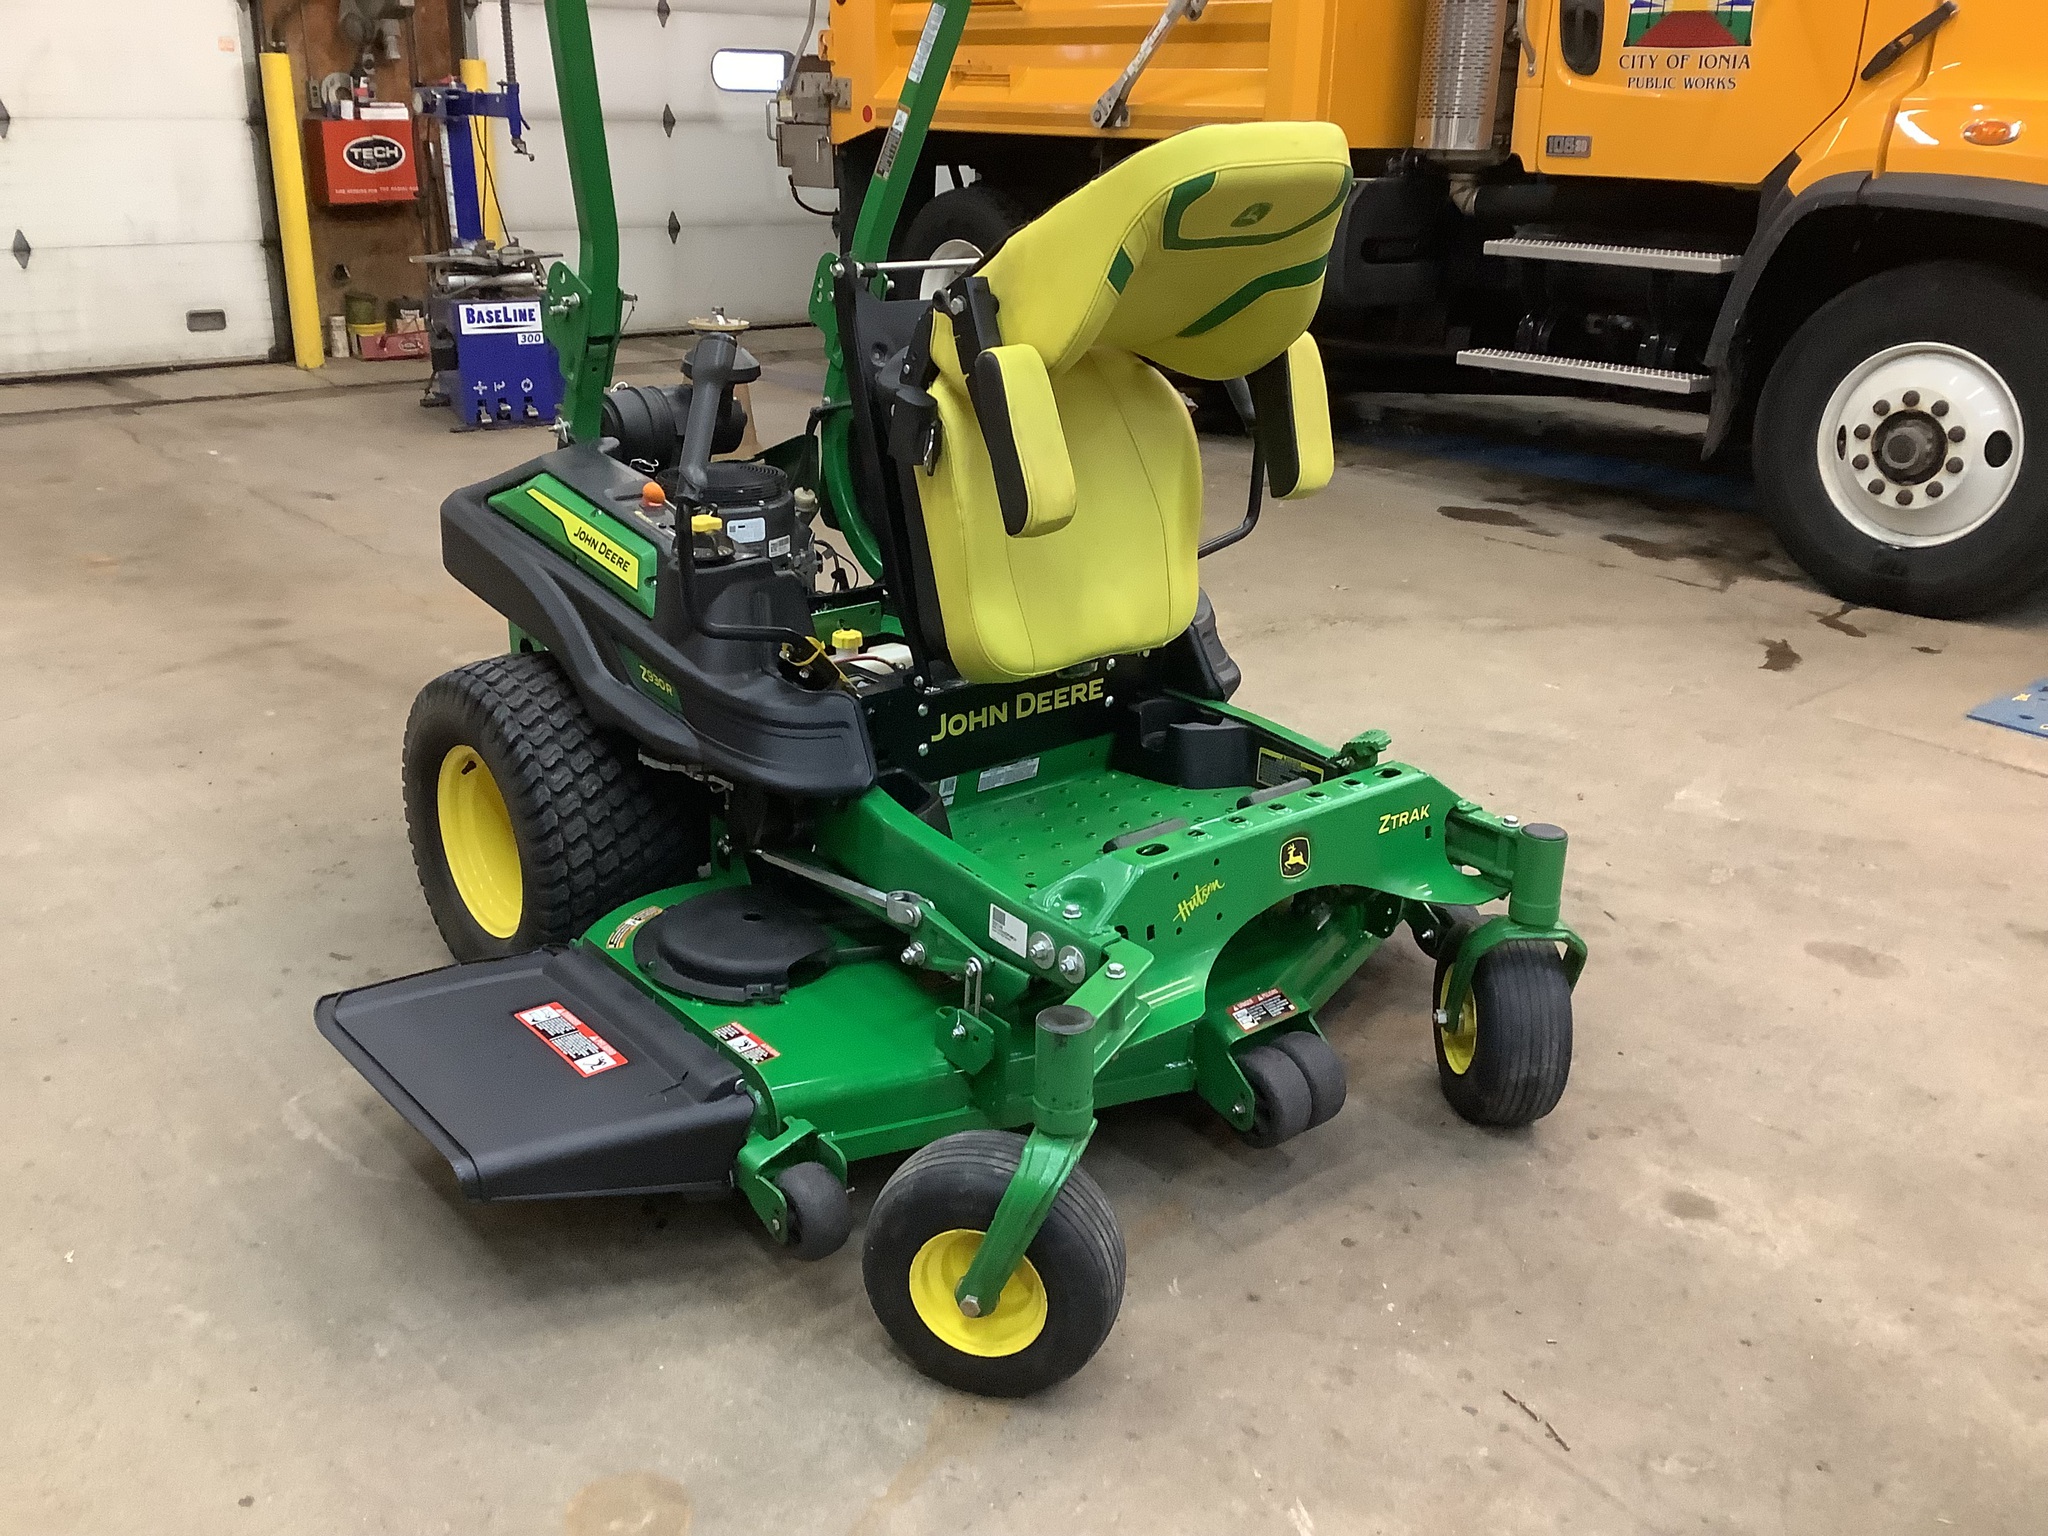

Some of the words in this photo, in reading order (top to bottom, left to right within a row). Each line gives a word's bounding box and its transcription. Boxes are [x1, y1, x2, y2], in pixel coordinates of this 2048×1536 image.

[1619, 54, 1659, 69] CITY
[1666, 54, 1691, 69] OF
[1698, 54, 1751, 69] IONIA
[1627, 77, 1677, 89] PUBLIC
[1684, 77, 1737, 90] WORKS
[349, 146, 400, 160] TECH
[520, 333, 542, 344] 300
[573, 526, 600, 551] JOHN
[597, 541, 631, 573] DEERE
[639, 664, 674, 697] Z930R
[931, 702, 1008, 742] JOHN
[1016, 678, 1105, 720] DEERE
[1378, 803, 1431, 835] ZTRAK
[1172, 879, 1226, 923] Hutson
